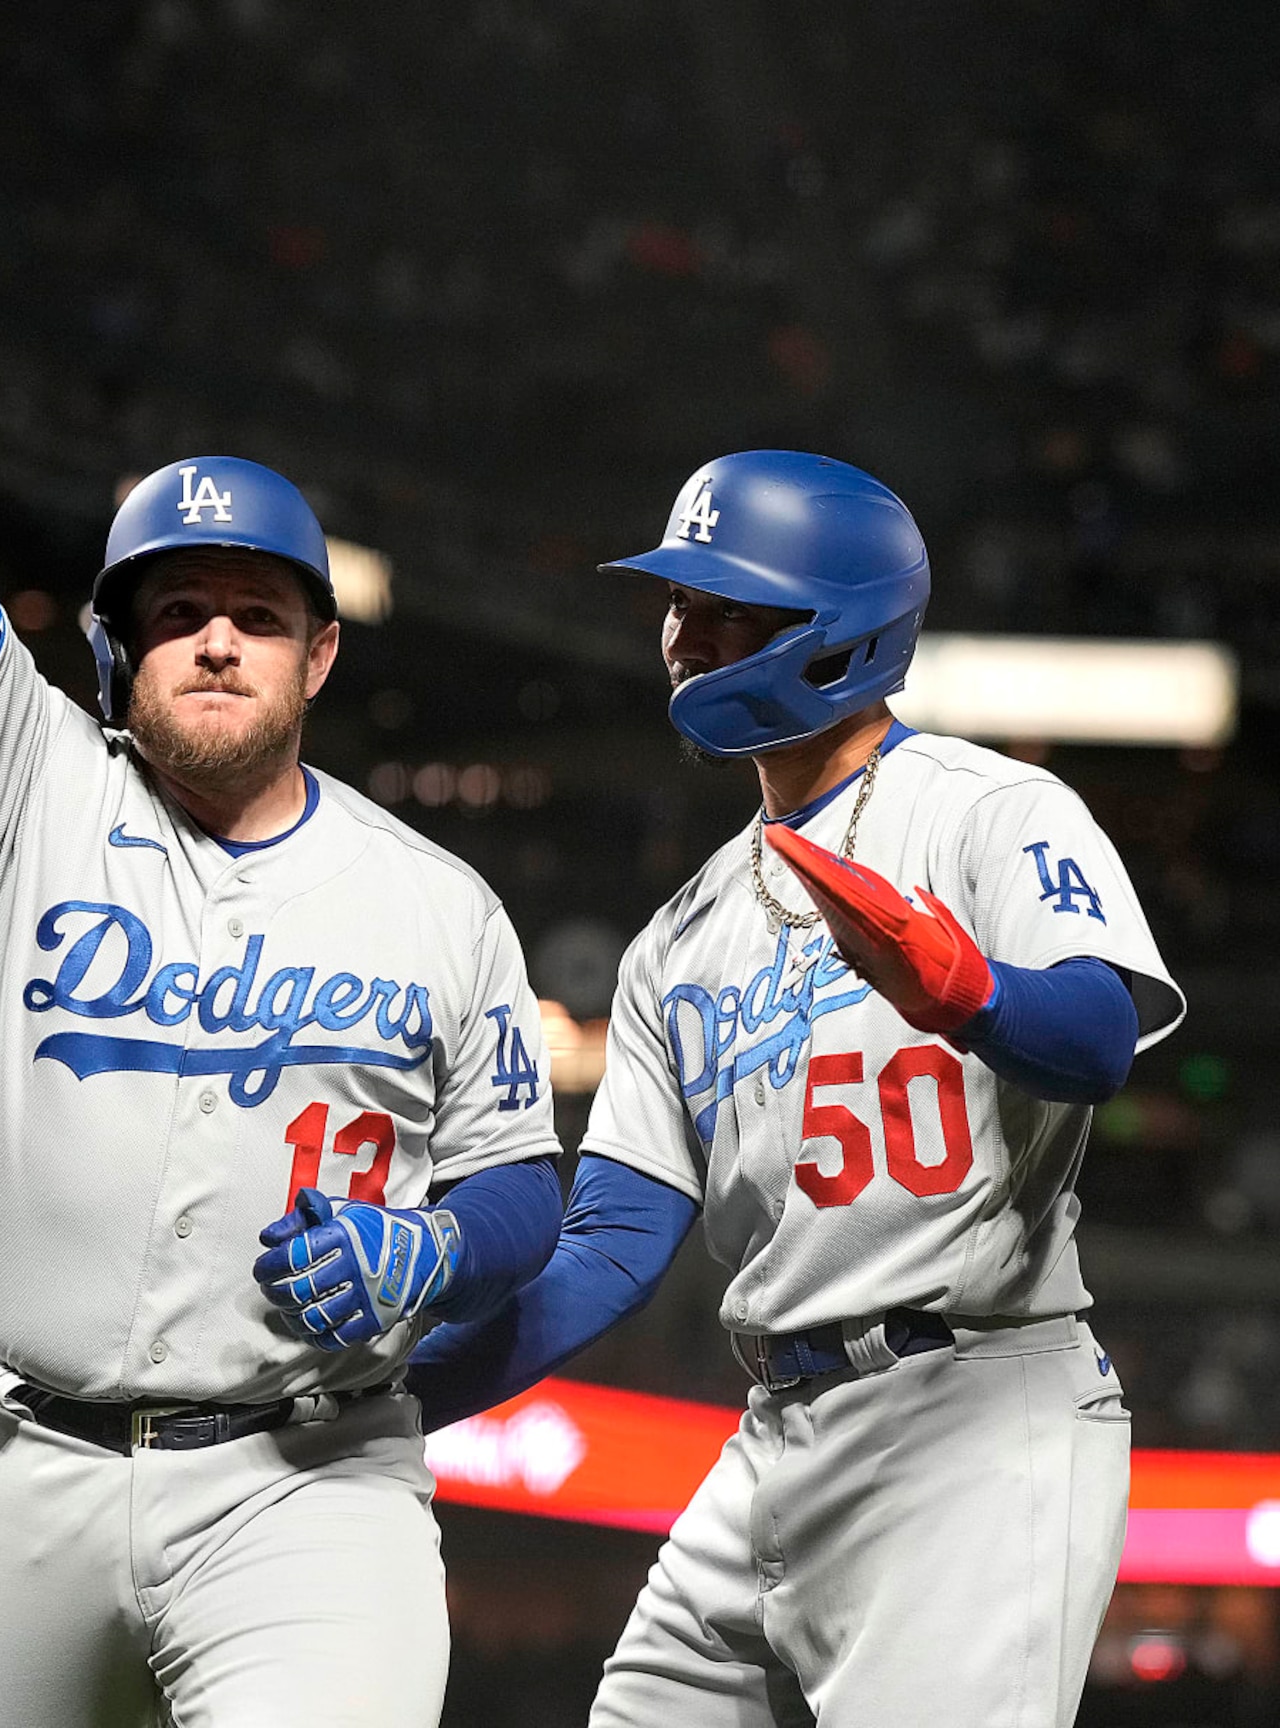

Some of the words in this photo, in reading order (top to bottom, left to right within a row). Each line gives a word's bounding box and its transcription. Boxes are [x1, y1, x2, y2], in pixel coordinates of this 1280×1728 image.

[177, 466, 233, 524] LA
[677, 475, 721, 544] LA
[1023, 841, 1107, 927] LA
[23, 901, 432, 1108] Dodgers
[485, 1003, 540, 1112] LA
[662, 921, 850, 1099] Dodge
[284, 1101, 396, 1214] 13
[794, 1044, 974, 1208] 50
